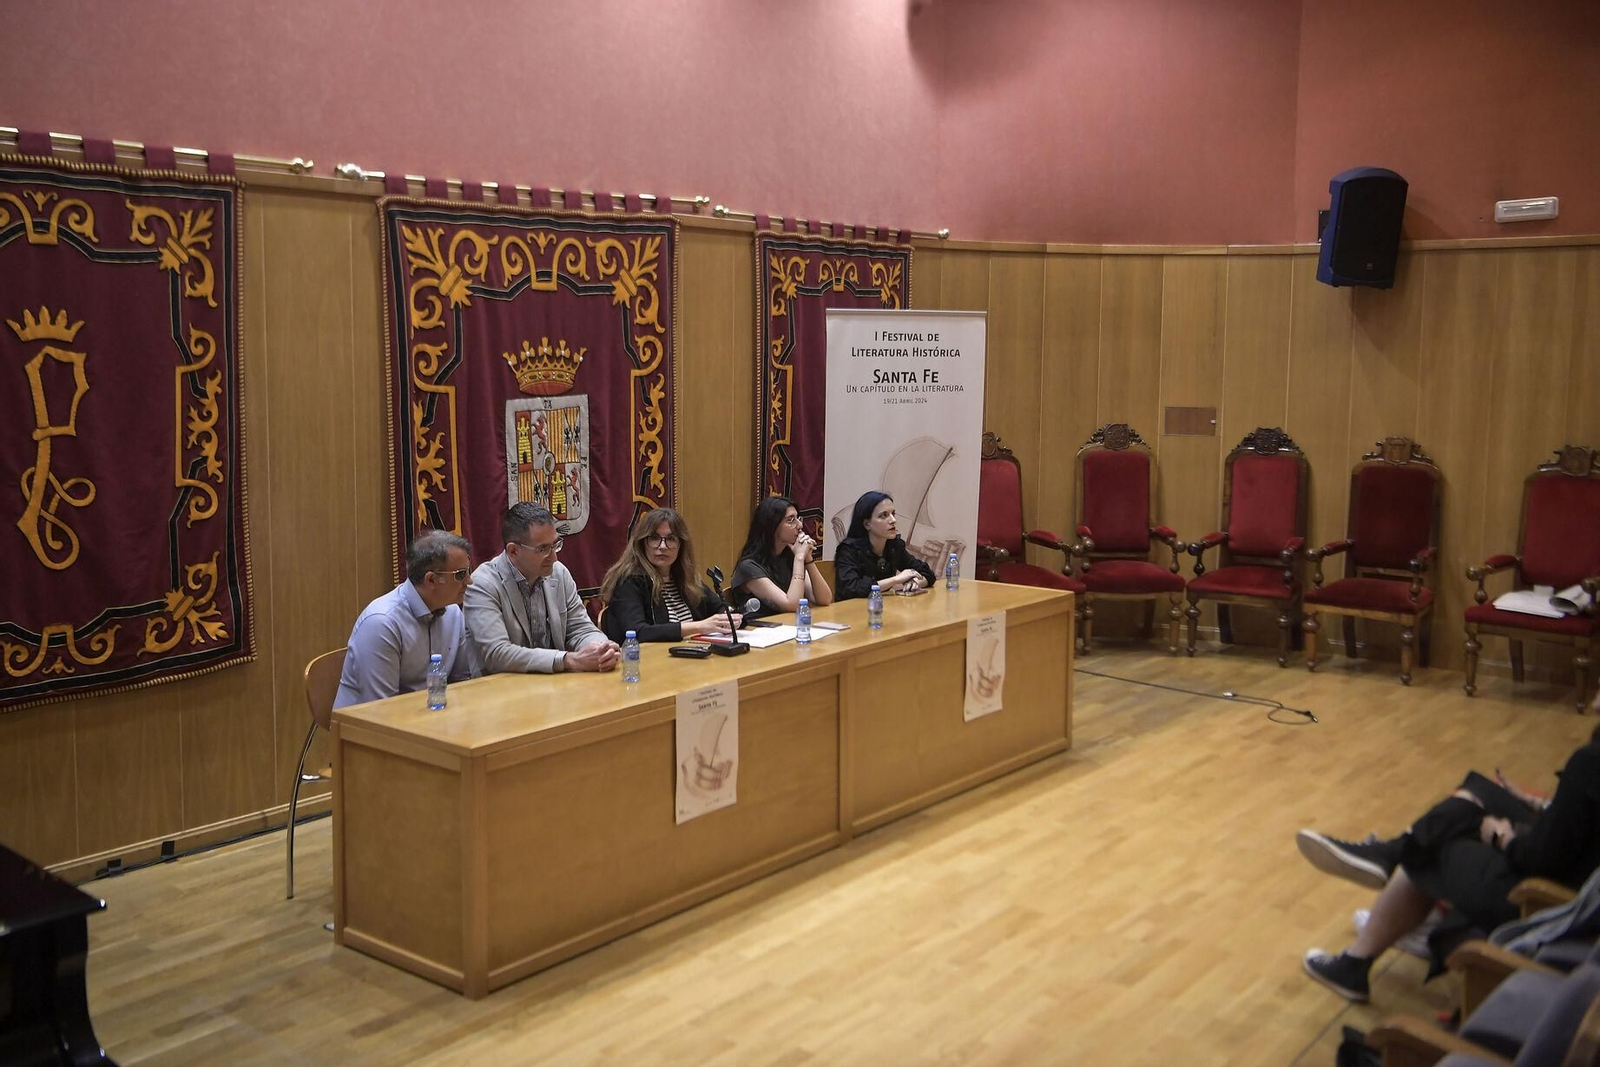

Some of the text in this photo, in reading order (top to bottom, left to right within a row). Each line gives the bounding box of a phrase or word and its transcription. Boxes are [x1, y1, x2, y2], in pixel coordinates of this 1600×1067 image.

[874, 331, 940, 342] I FESTIVAL DE
[851, 346, 960, 357] LITERATURA HISTÓRICA
[873, 369, 939, 384] SANTA FE
[846, 385, 857, 393] UN
[860, 384, 896, 393] CAPÍTULO
[898, 385, 908, 393] EN
[922, 385, 964, 393] LITERATURA
[510, 462, 518, 482] SAN
